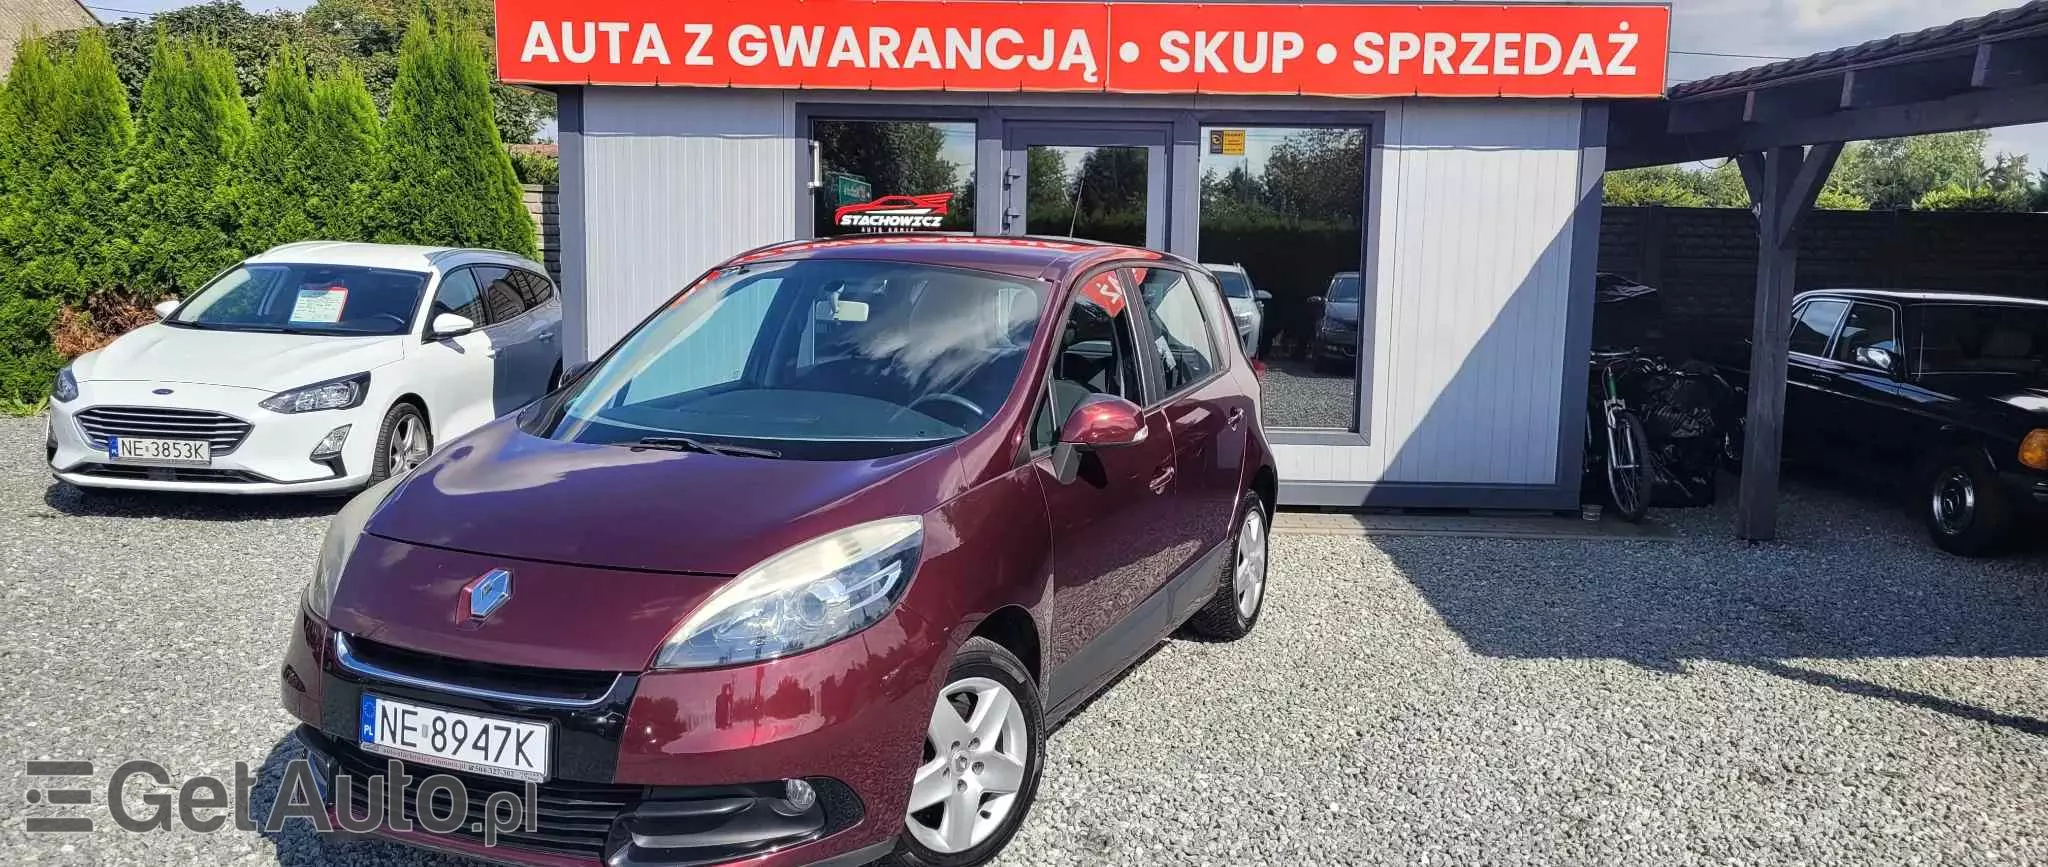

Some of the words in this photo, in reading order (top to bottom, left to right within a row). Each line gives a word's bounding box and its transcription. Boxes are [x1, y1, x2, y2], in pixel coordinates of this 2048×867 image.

[521, 20, 672, 65] AUTA
[685, 25, 714, 65] Z
[728, 25, 1098, 82] GWARANCJĄ
[1159, 30, 1304, 73] SKUP
[1352, 21, 1638, 76] SPRZEDAŻ
[840, 215, 944, 227] STACHOWICZ
[121, 440, 143, 457] NE
[151, 442, 204, 459] 3853K
[363, 724, 374, 736] PL
[380, 704, 418, 748] NE
[431, 715, 534, 768] 8947K
